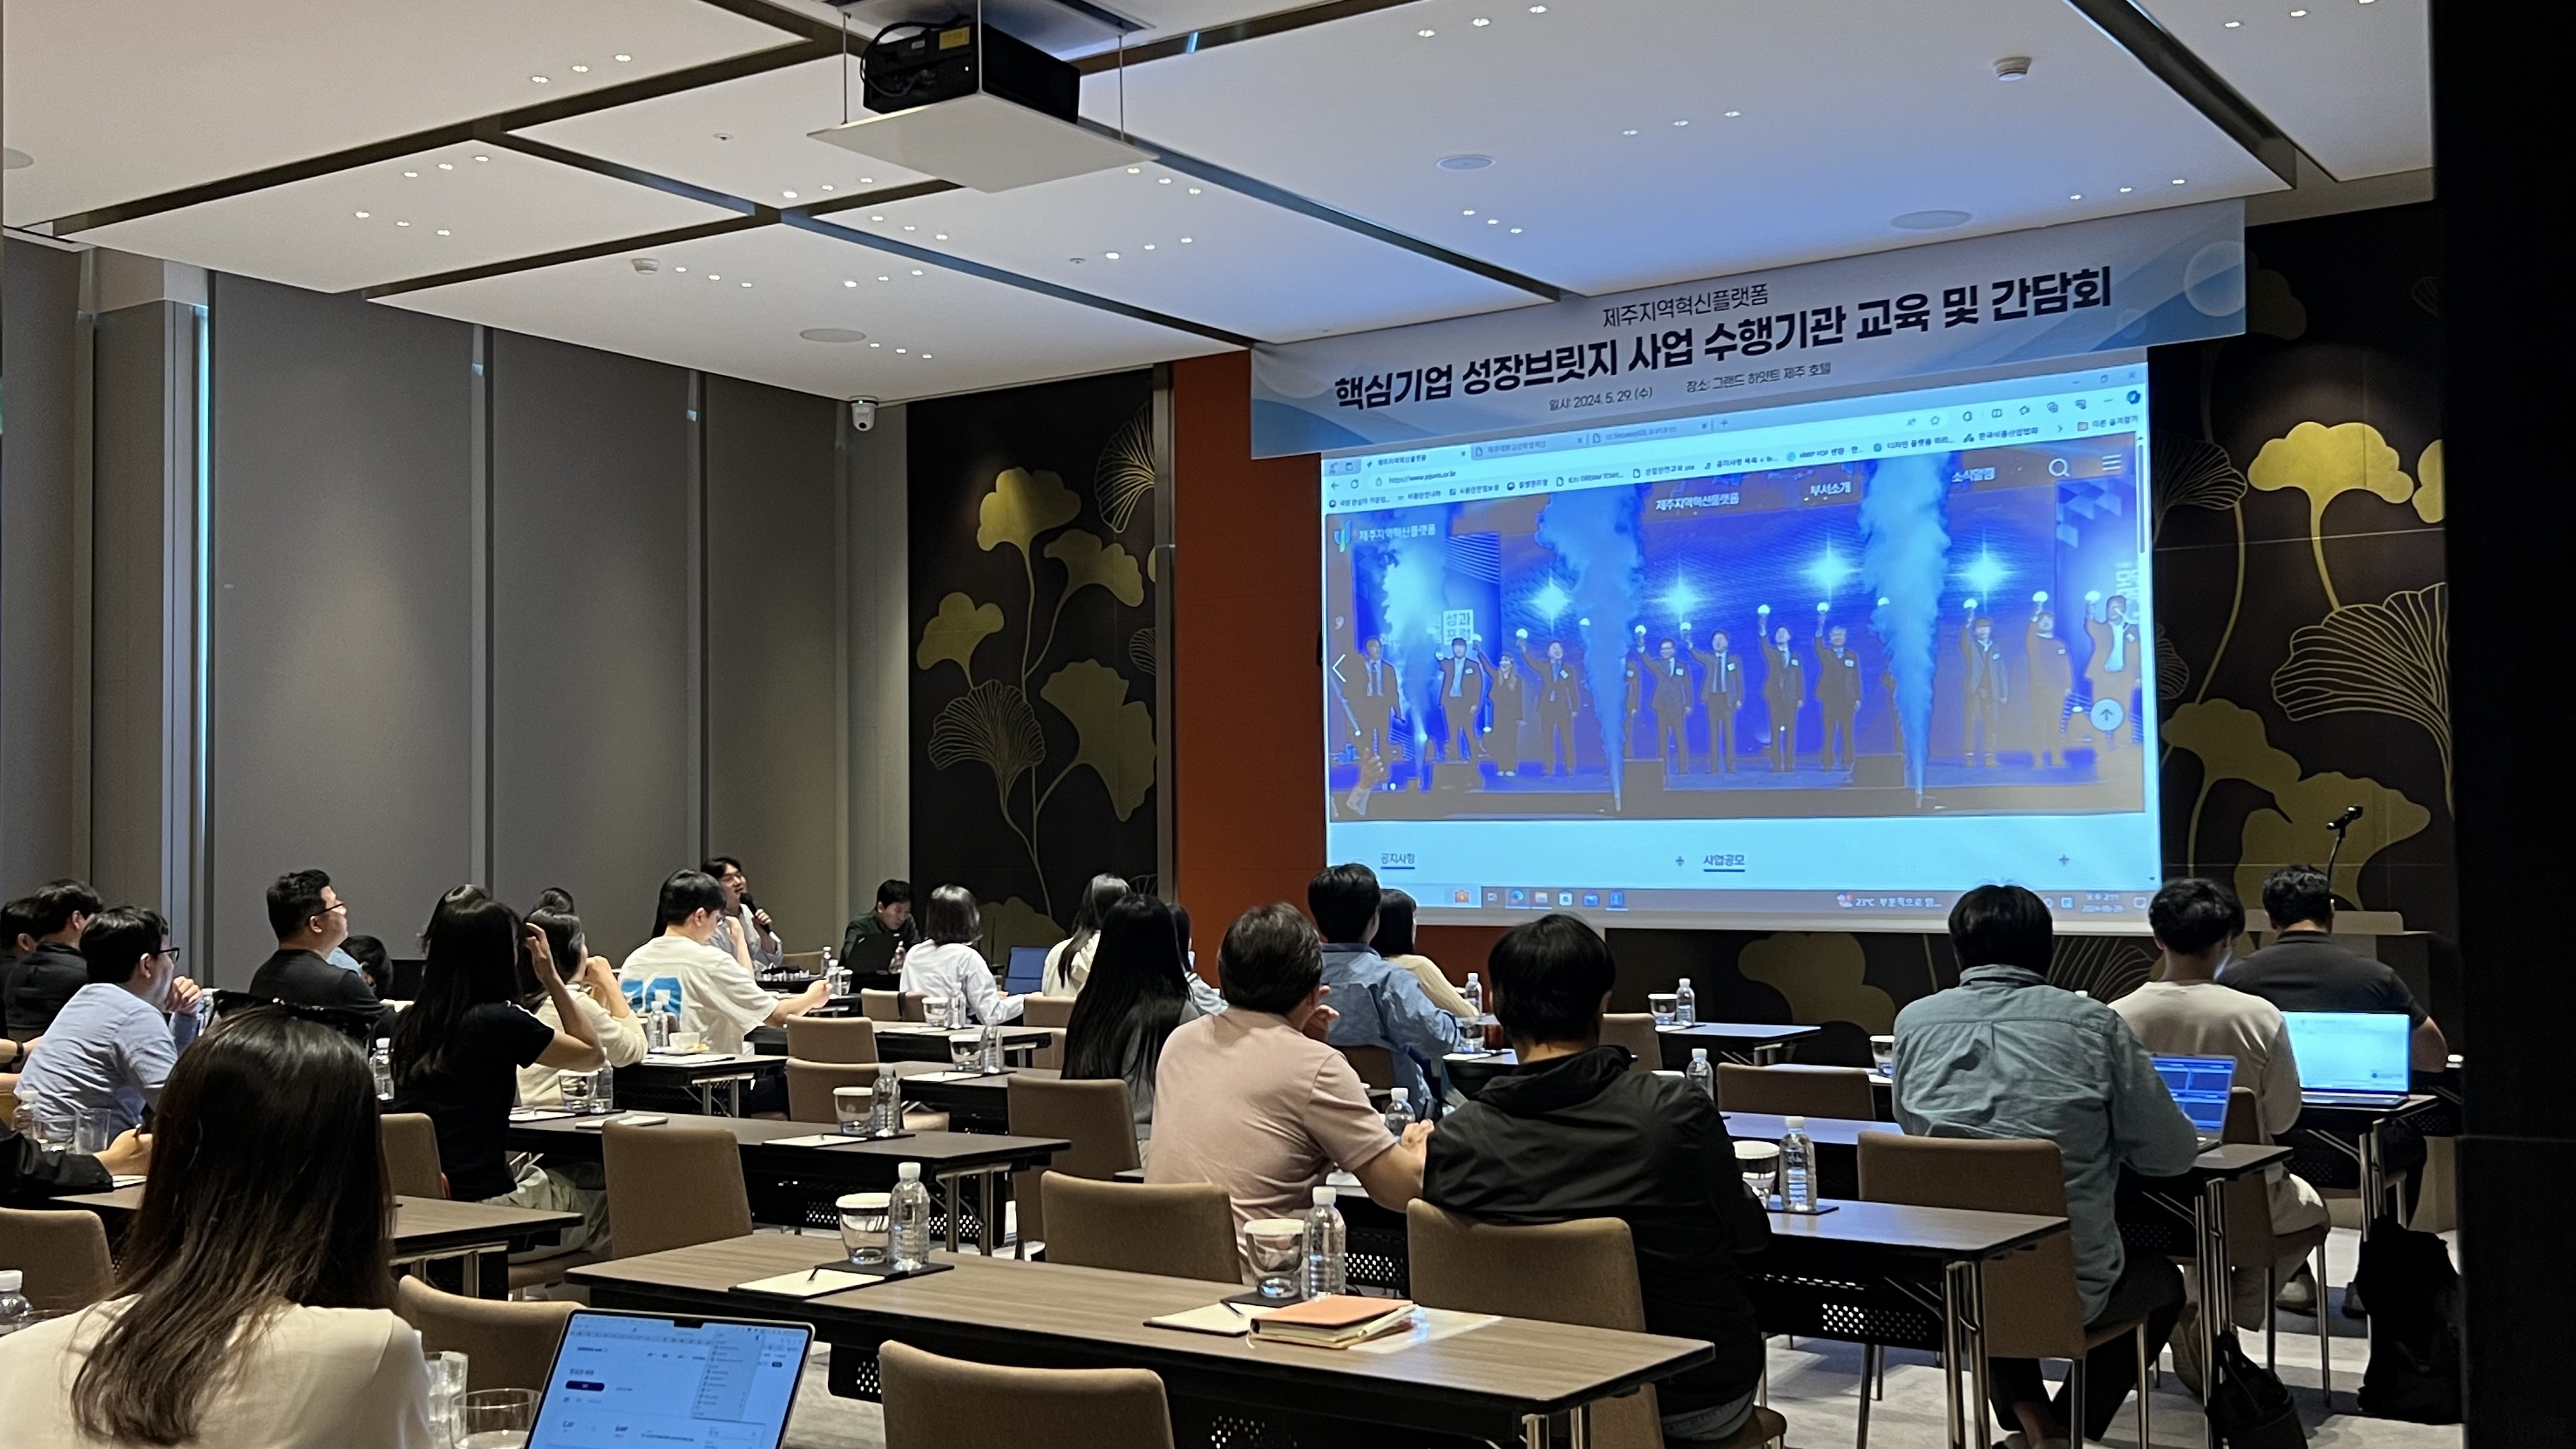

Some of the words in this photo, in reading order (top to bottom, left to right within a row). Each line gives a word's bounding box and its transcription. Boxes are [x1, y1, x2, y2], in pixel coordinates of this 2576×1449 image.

[1602, 282, 1769, 328] 제주지역혁신플랫폼
[1335, 364, 1453, 411] 핵심기업
[1461, 338, 1618, 395] 성장브릿지
[1628, 327, 1693, 371] 사업
[1704, 305, 1847, 362] 수행기관
[1856, 292, 1931, 340] 교육
[1943, 283, 1979, 328] 및
[1990, 265, 2112, 318] 간담회
[1713, 374, 1745, 390] 그랜드
[1783, 365, 1807, 379] 제주
[1809, 362, 1832, 376] 호텔
[1810, 481, 1851, 496] 부서소개
[1655, 491, 1739, 510] 제주지역혁신플랫폼
[1359, 523, 1436, 541] 제주지역혁신플랫폼
[1381, 853, 1415, 864] 공지사항
[1703, 854, 1745, 866] 사업공모
